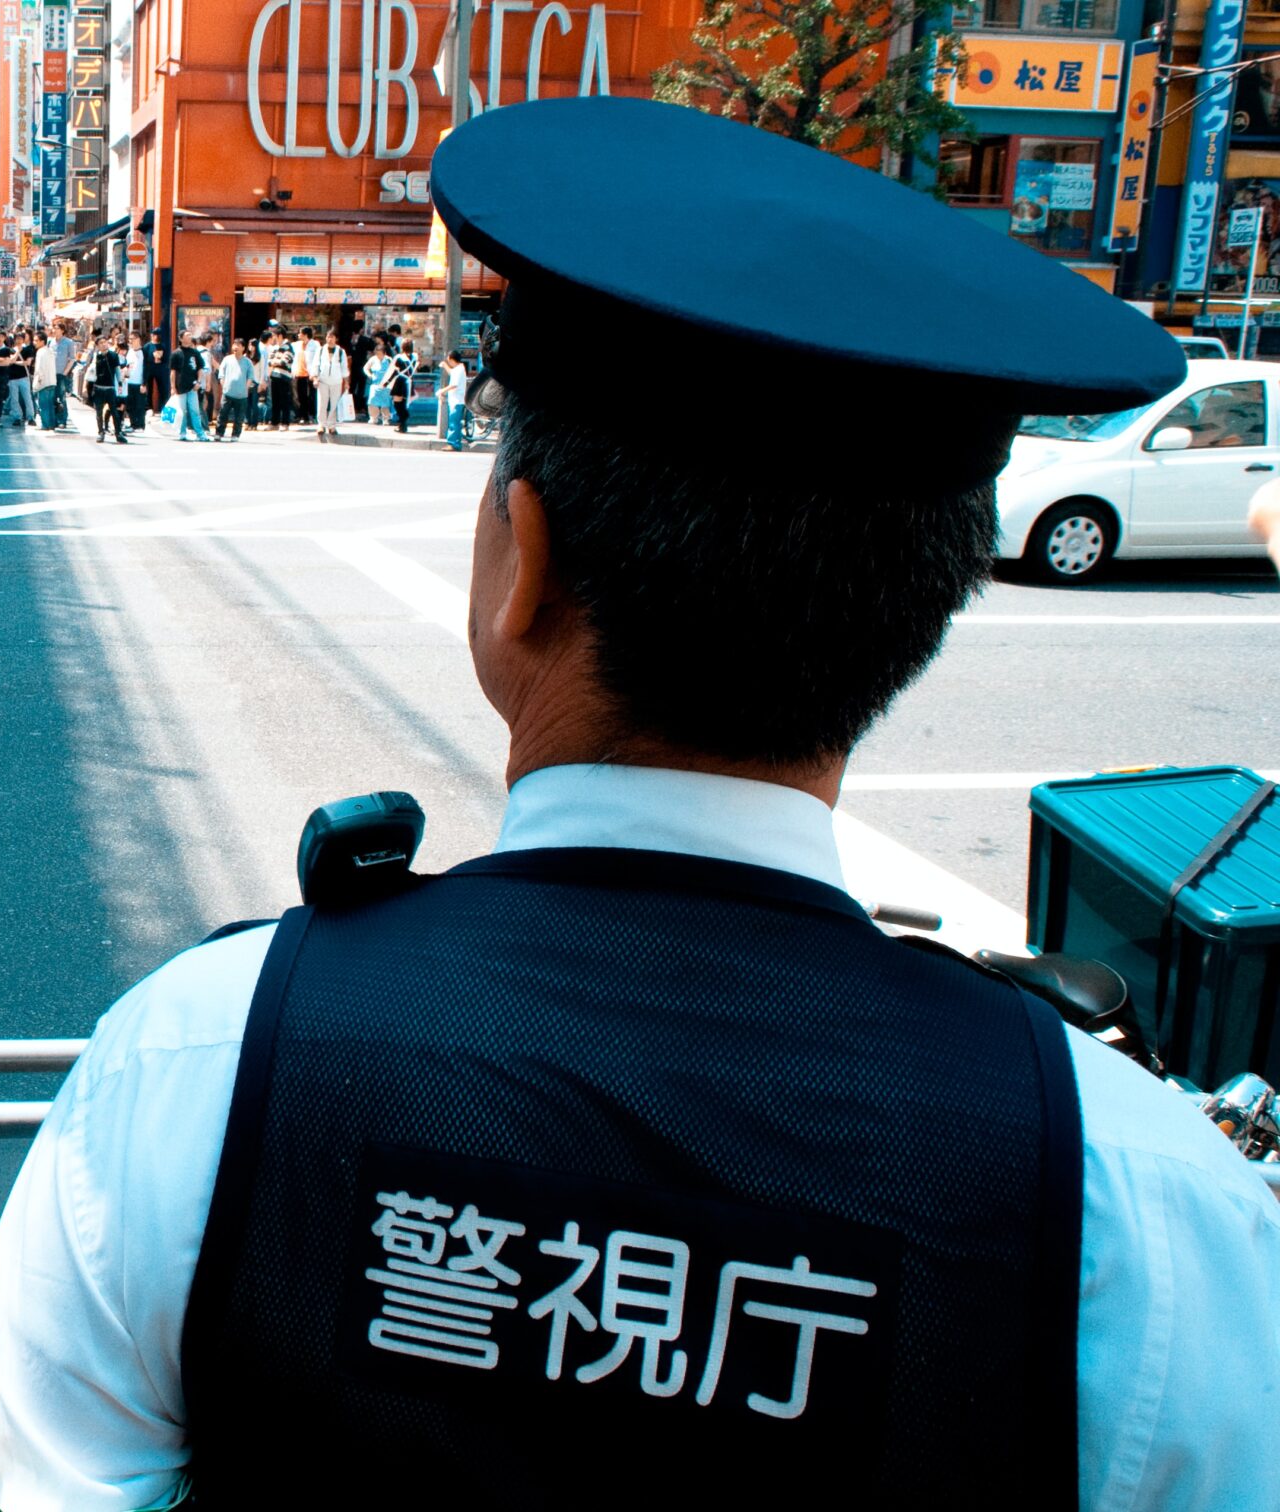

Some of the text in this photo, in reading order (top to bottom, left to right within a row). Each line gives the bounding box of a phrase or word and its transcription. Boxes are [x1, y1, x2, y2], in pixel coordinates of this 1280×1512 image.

[74, 0, 102, 207] オデパート
[247, 0, 611, 159] CLUB EGA
[1014, 59, 1083, 93] 松屋
[1120, 138, 1146, 201] 松屋
[290, 256, 419, 268] SEGA SEGA
[1182, 193, 1215, 286] ソフマップ
[365, 1190, 878, 1420] 警視庁
